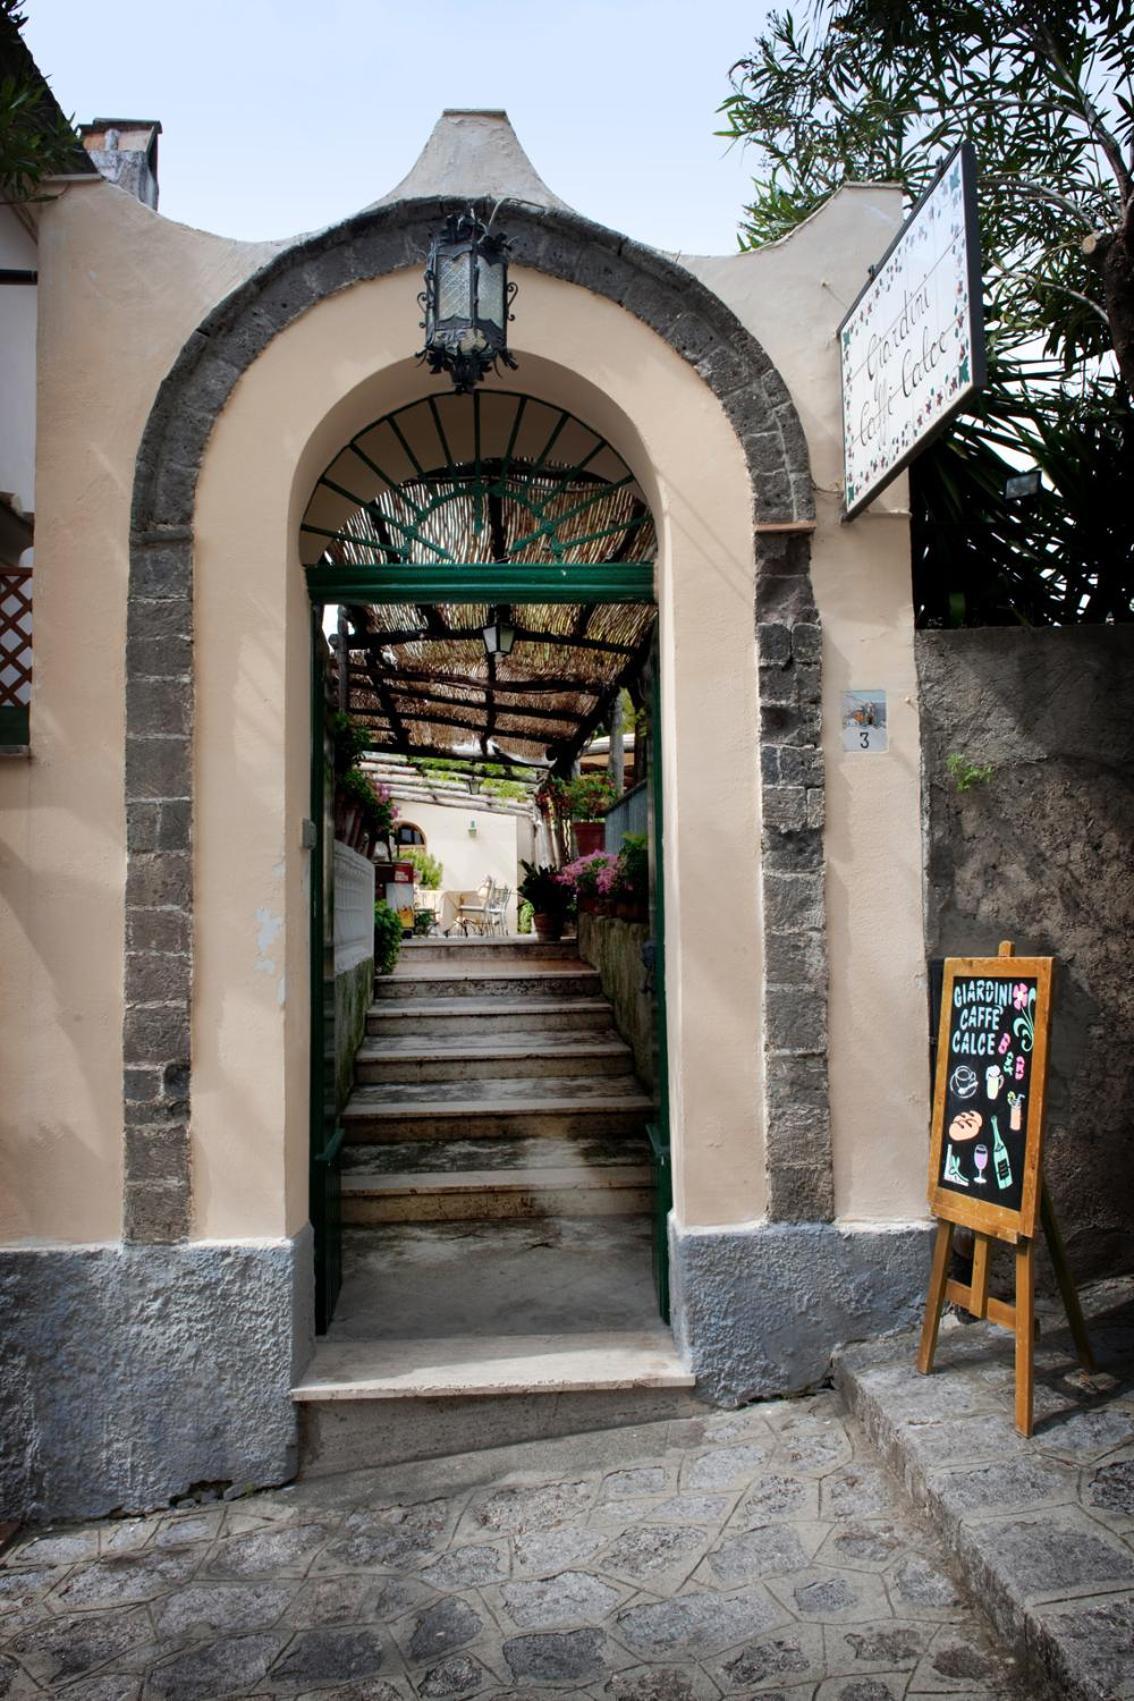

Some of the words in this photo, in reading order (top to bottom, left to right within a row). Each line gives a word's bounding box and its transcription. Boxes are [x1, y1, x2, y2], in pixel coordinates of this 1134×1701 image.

[867, 275, 930, 381] Giardini
[902, 326, 947, 398] Calce
[859, 731, 870, 749] 3
[954, 980, 1012, 1008] GIARDINI
[952, 1030, 996, 1056] CALCE
